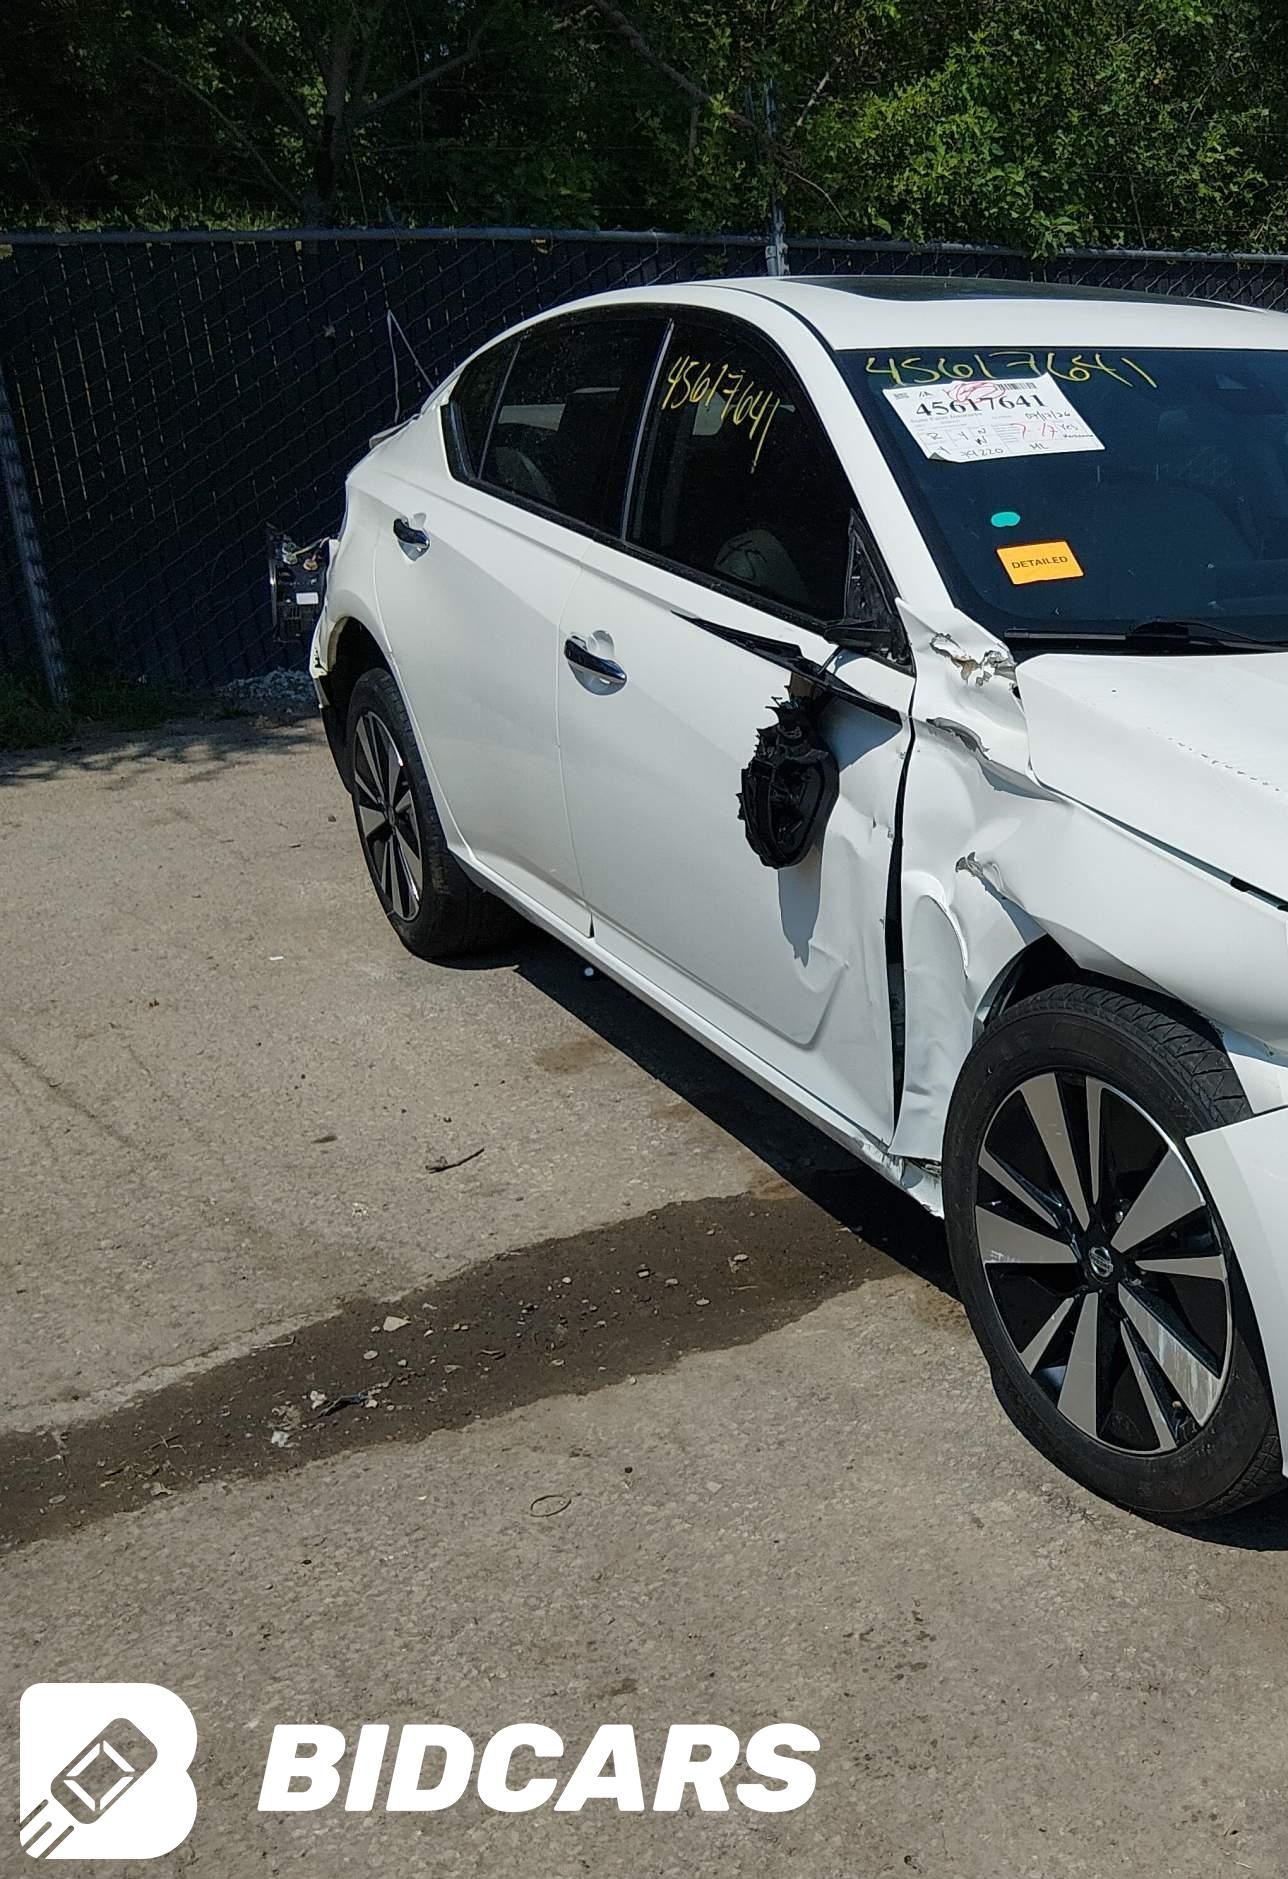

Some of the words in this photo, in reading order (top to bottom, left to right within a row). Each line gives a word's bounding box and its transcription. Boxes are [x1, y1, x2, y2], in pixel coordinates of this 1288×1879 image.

[865, 351, 1157, 388] 45617641
[661, 355, 781, 474] 45617641
[916, 394, 1046, 416] 45617641
[1011, 556, 1068, 569] DETAILED
